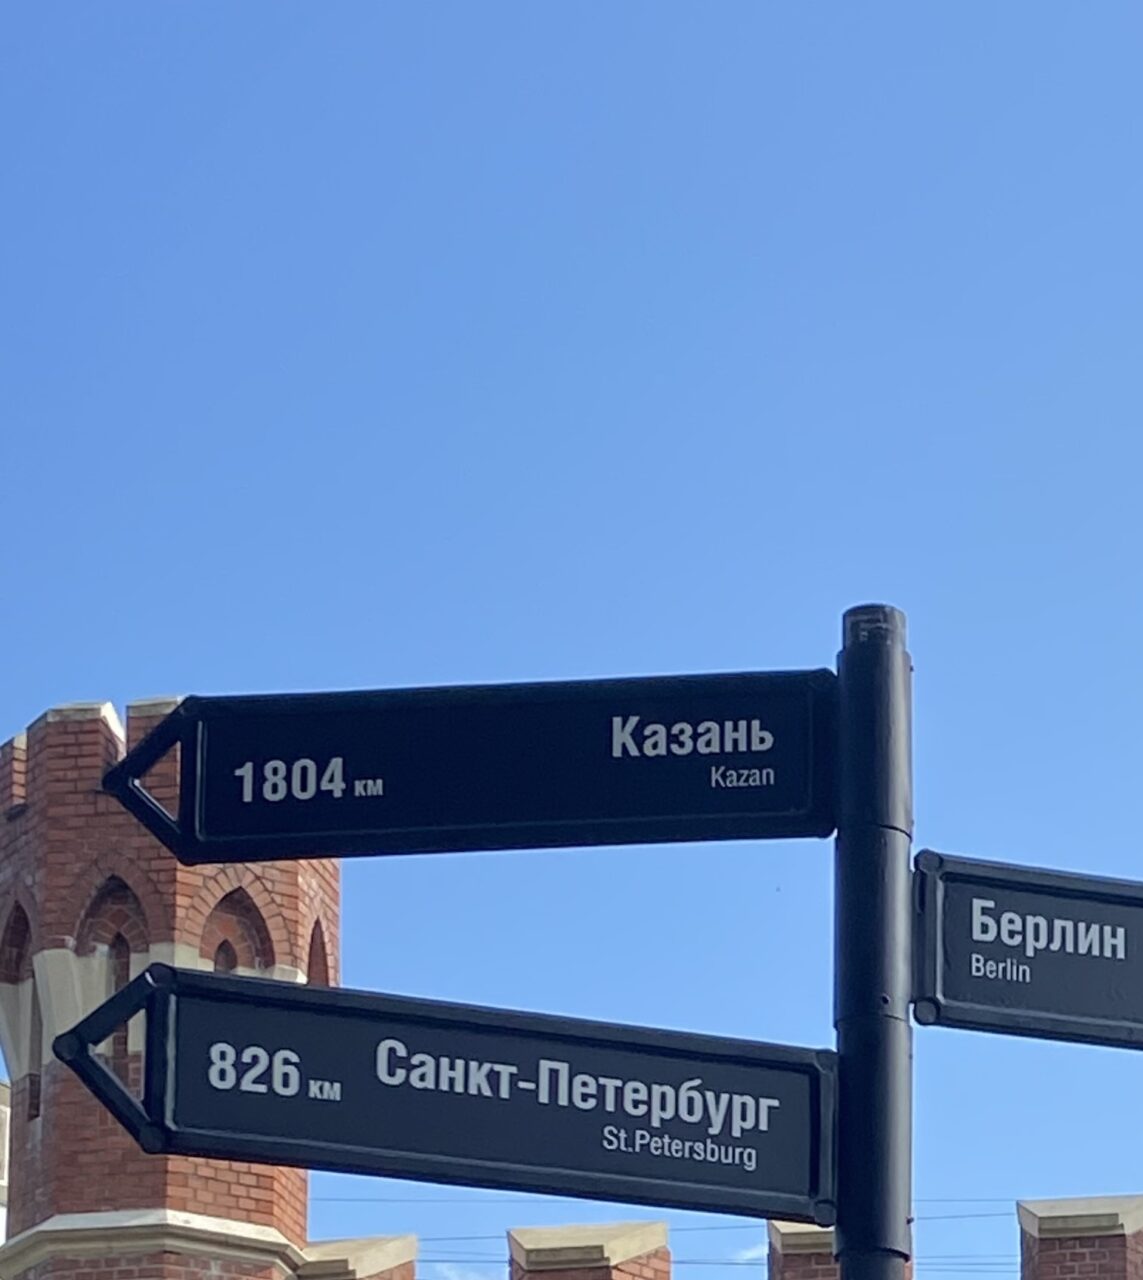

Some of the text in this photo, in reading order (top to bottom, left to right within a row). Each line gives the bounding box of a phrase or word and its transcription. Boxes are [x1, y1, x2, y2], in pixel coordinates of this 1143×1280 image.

[611, 715, 775, 758] Казань
[233, 757, 387, 803] 1804 км
[709, 766, 775, 789] Kazan
[970, 897, 1127, 960] Берлин
[970, 952, 1032, 983] Berlin
[208, 1041, 342, 1102] 826 км
[375, 1037, 780, 1139] Санкт-Петербург
